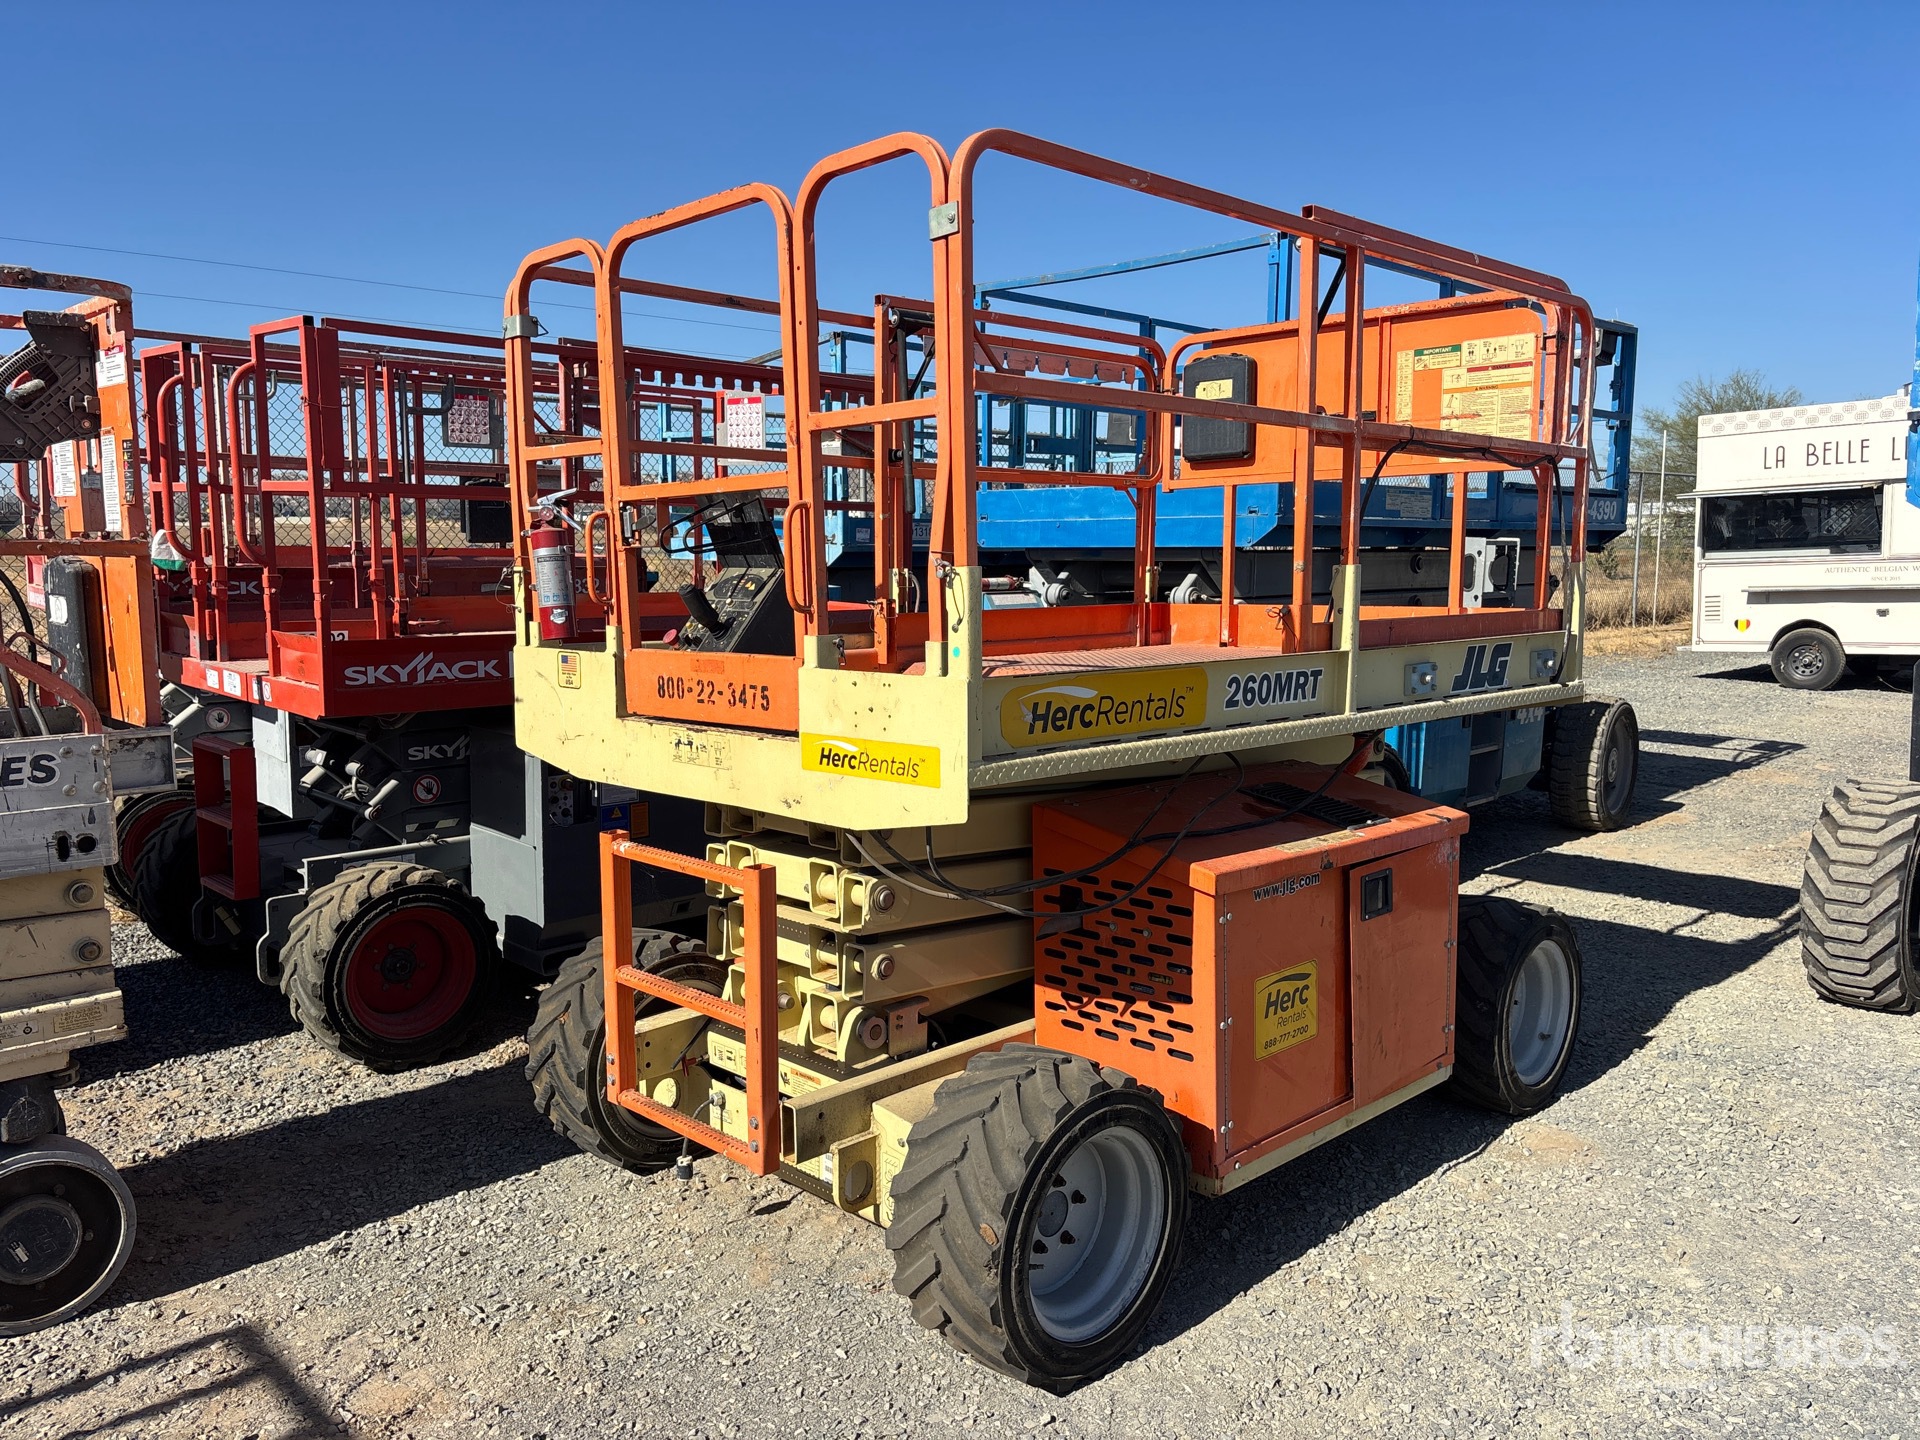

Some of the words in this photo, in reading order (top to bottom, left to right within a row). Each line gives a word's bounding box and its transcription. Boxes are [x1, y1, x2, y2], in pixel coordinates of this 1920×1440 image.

[1423, 346, 1453, 355] IMPORTANT
[1763, 445, 1786, 470] LA
[1806, 438, 1870, 467] BELLE
[1824, 566, 1871, 574] AUTHENTIC
[344, 651, 502, 686] SKYJACK
[1450, 642, 1513, 693] JLG
[657, 675, 770, 711] 800-22-3475
[1224, 668, 1325, 711] 260MRT
[1253, 872, 1320, 901] www.jlg.com
[1264, 984, 1310, 1019] Herc
[1277, 1008, 1307, 1029] Rentals
[1264, 1024, 1309, 1050] 888-777-2700
